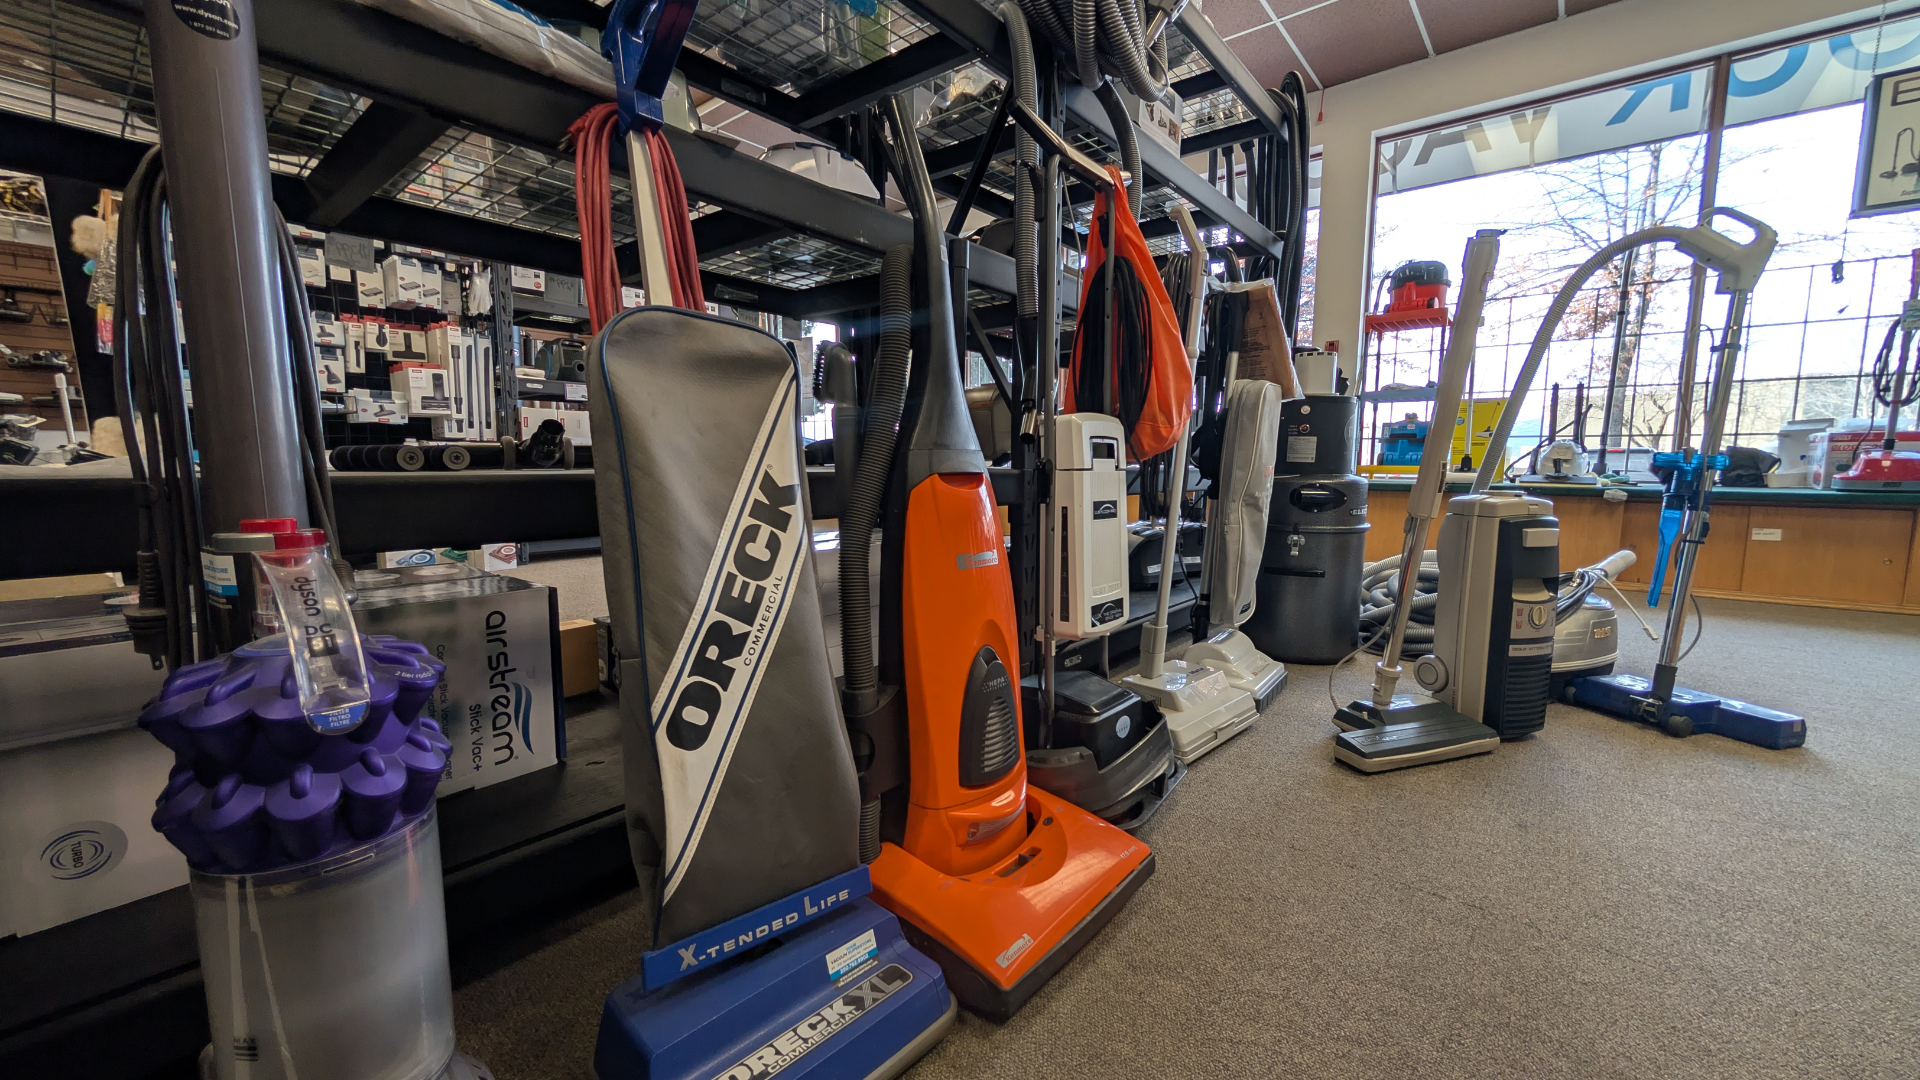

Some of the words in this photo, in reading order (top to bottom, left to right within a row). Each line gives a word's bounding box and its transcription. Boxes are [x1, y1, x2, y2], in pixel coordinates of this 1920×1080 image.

[174, 4, 239, 29] www.dyson.com
[966, 557, 998, 568] Kenmore
[290, 576, 321, 616] dyson
[666, 470, 799, 752] ORECK
[743, 574, 785, 667] COMMERCIAL
[305, 622, 333, 636] DC
[437, 644, 447, 683] Corss
[439, 683, 449, 705] Stick
[485, 610, 517, 767] airstream
[989, 676, 1005, 687] HEPA
[329, 714, 351, 722] FILTRO
[330, 719, 351, 727] FILTRE
[469, 703, 483, 735] Stick
[471, 736, 484, 772] Vac+
[71, 841, 84, 869] TURBO
[678, 911, 800, 972] X-TENDED
[804, 887, 851, 917] LIFE
[830, 951, 848, 965] VACUUM
[848, 937, 872, 955] SUPERSTORE
[846, 942, 857, 951] YOUR
[1004, 936, 1034, 964] Kenmore
[713, 999, 857, 1080] ORECK
[848, 974, 906, 1009] XL
[766, 1009, 863, 1073] COMMERCIAL
